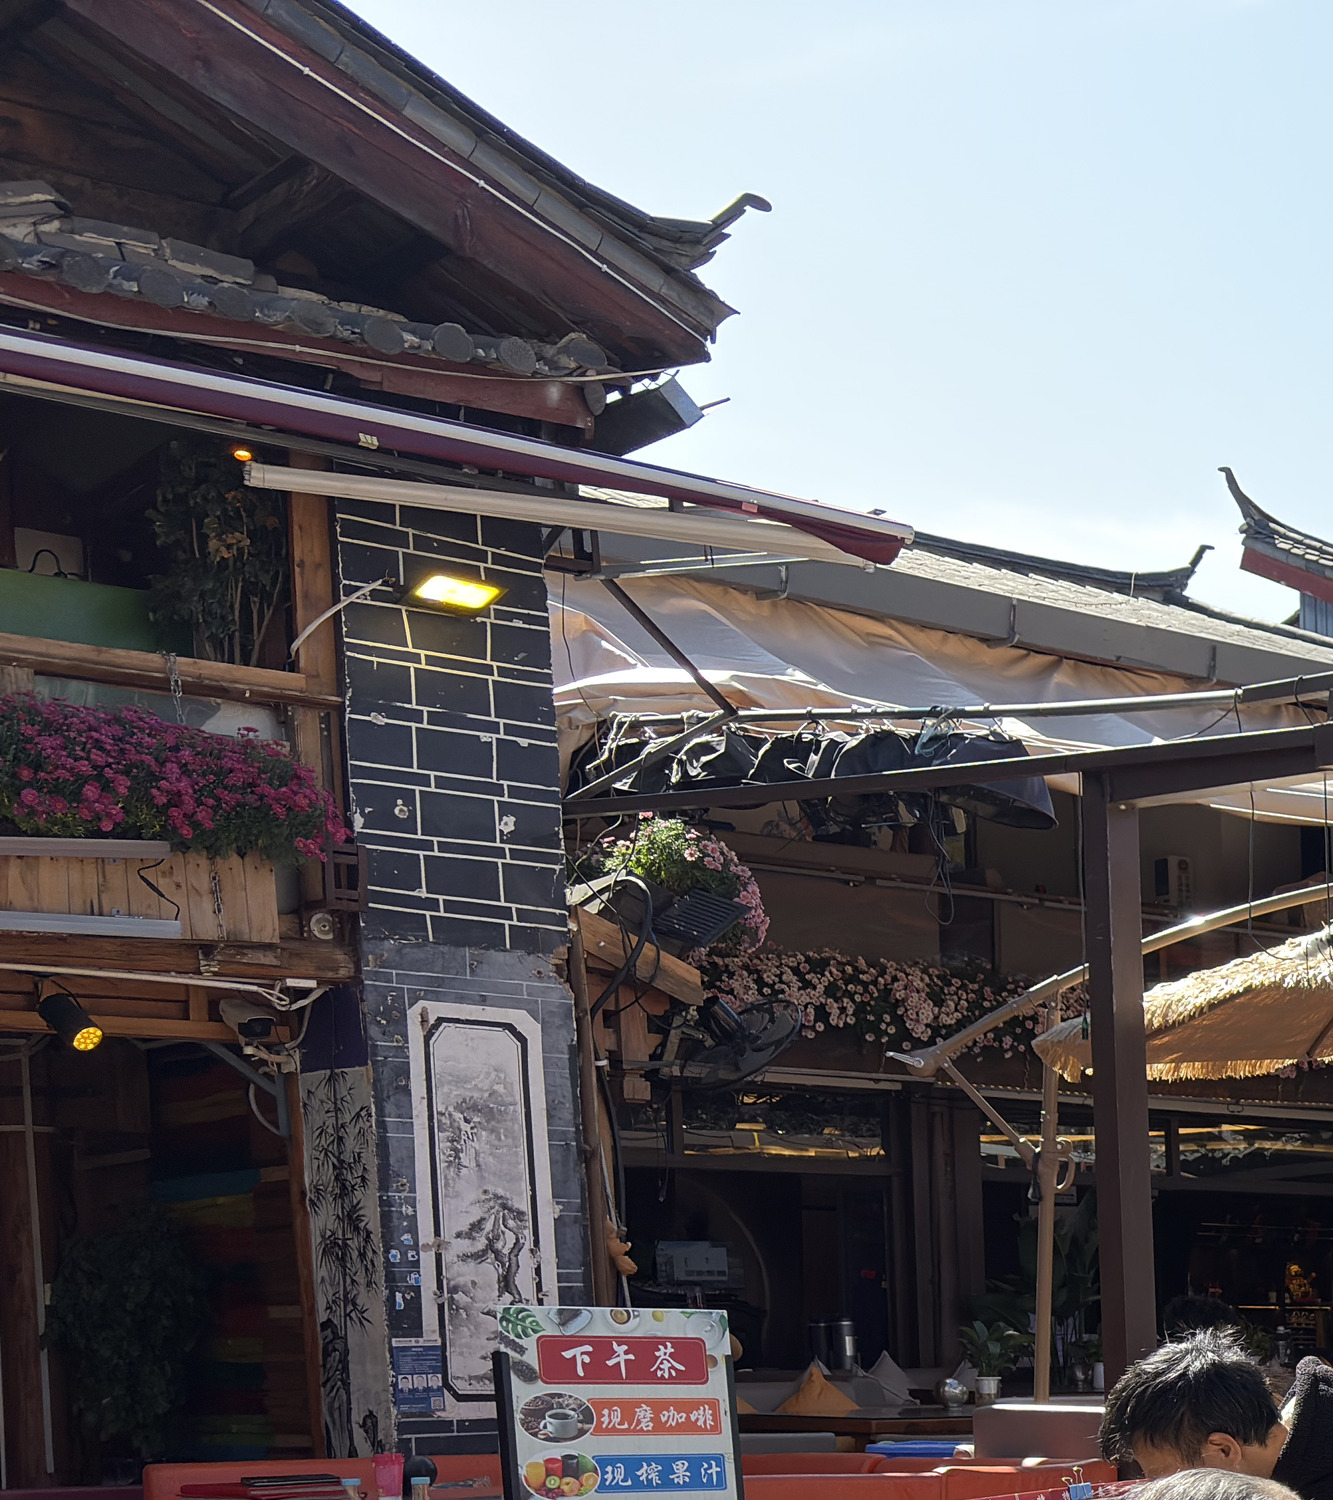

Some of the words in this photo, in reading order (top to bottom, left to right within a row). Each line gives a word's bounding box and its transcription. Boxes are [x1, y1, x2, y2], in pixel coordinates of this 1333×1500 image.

[560, 1341, 686, 1380] 下午茶
[600, 1403, 715, 1431] 现磨咖啡
[603, 1460, 722, 1487] 现榨果汁
